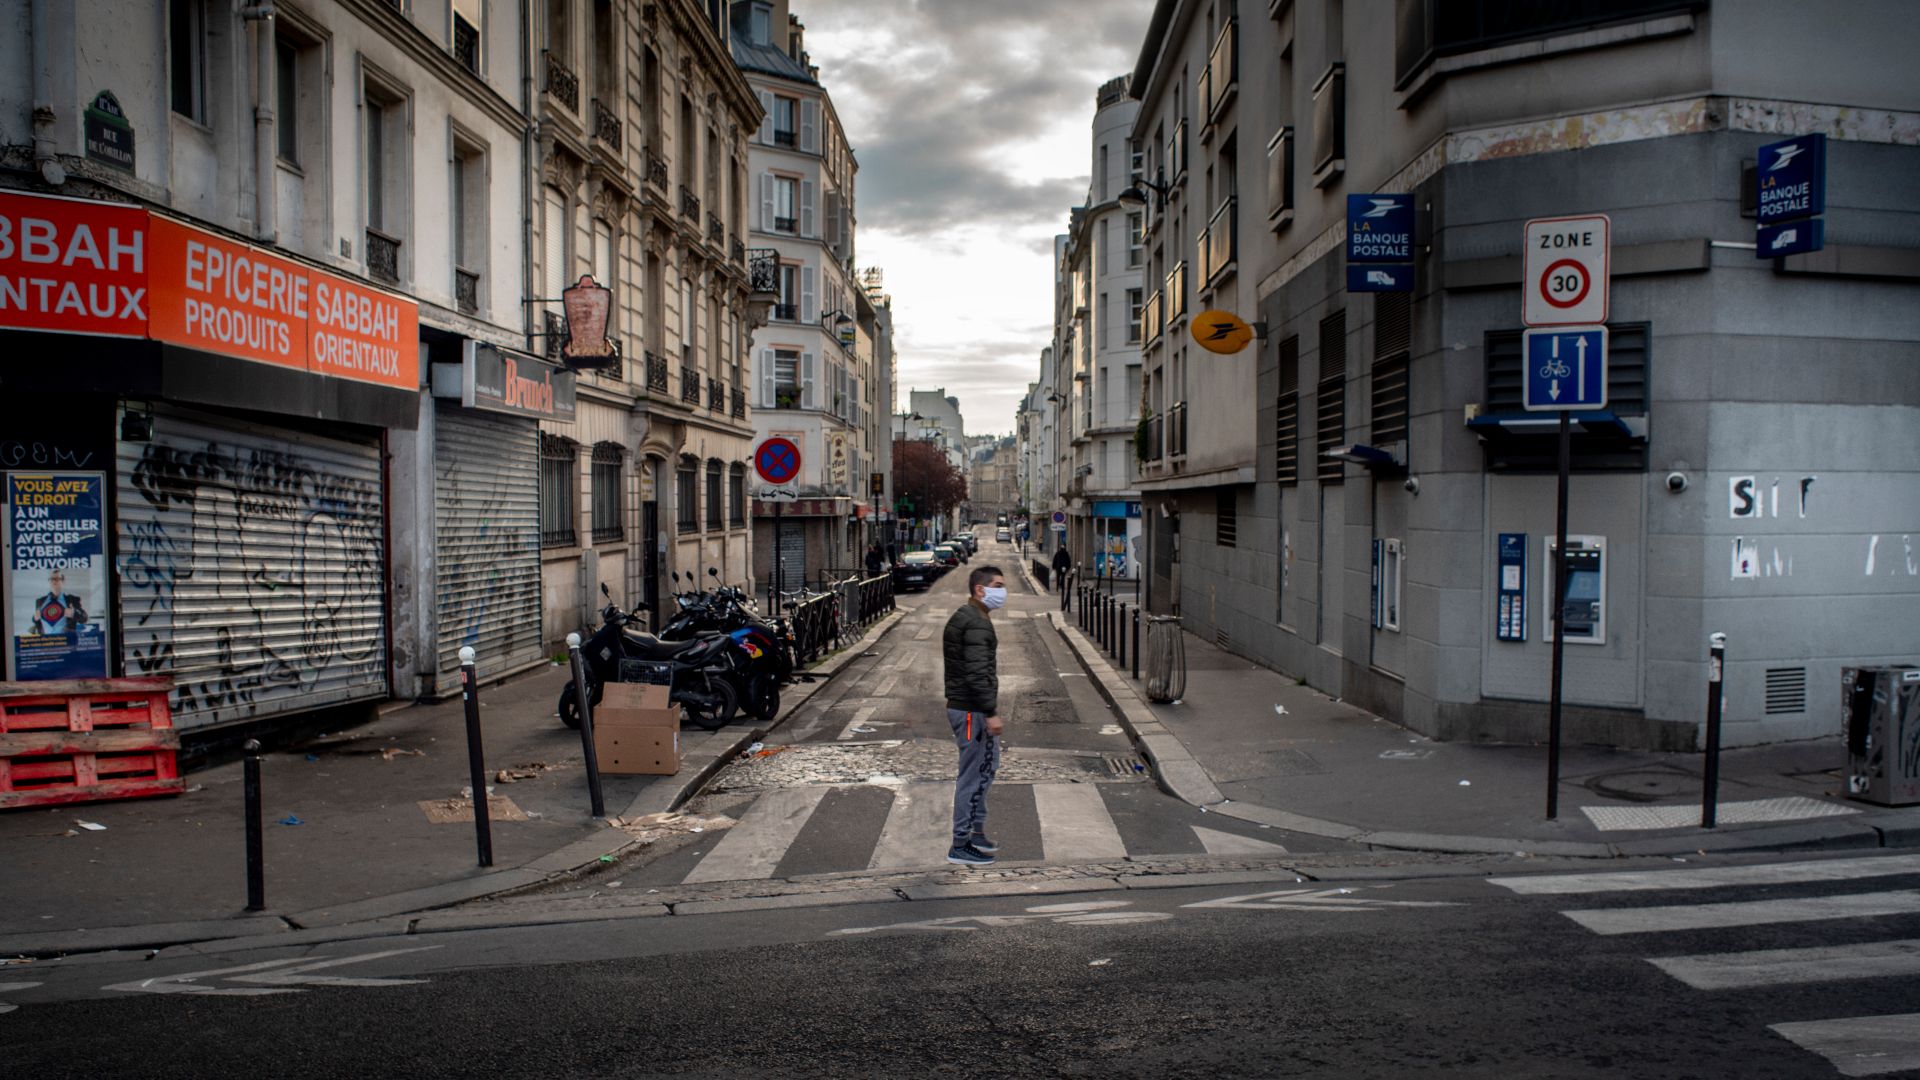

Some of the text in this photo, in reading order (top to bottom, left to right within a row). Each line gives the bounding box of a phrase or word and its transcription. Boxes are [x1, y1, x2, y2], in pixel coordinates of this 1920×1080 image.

[1760, 176, 1776, 189] LA
[1760, 181, 1810, 203] BANQUE
[1760, 196, 1810, 217] POSTALE
[1353, 221, 1371, 232] LA
[1353, 233, 1409, 245] BANQUE
[1540, 231, 1593, 249] ZONE
[1353, 245, 1409, 256] POSTALE
[1552, 274, 1579, 293] 30
[185, 240, 399, 342] EPICERIE SABBAH
[0, 275, 147, 320] NTAUX
[185, 298, 400, 378] PRODUITS ORIENTAUX
[504, 357, 553, 414] Brunch
[15, 481, 89, 492] VOUS AVEZ
[15, 494, 78, 505] LE DROIT
[15, 506, 49, 518] À UN
[15, 520, 99, 531] CONSEILLER
[16, 532, 80, 544] AVEC DES
[16, 545, 68, 557] CYBER-
[17, 558, 89, 570] POUVOIRS
